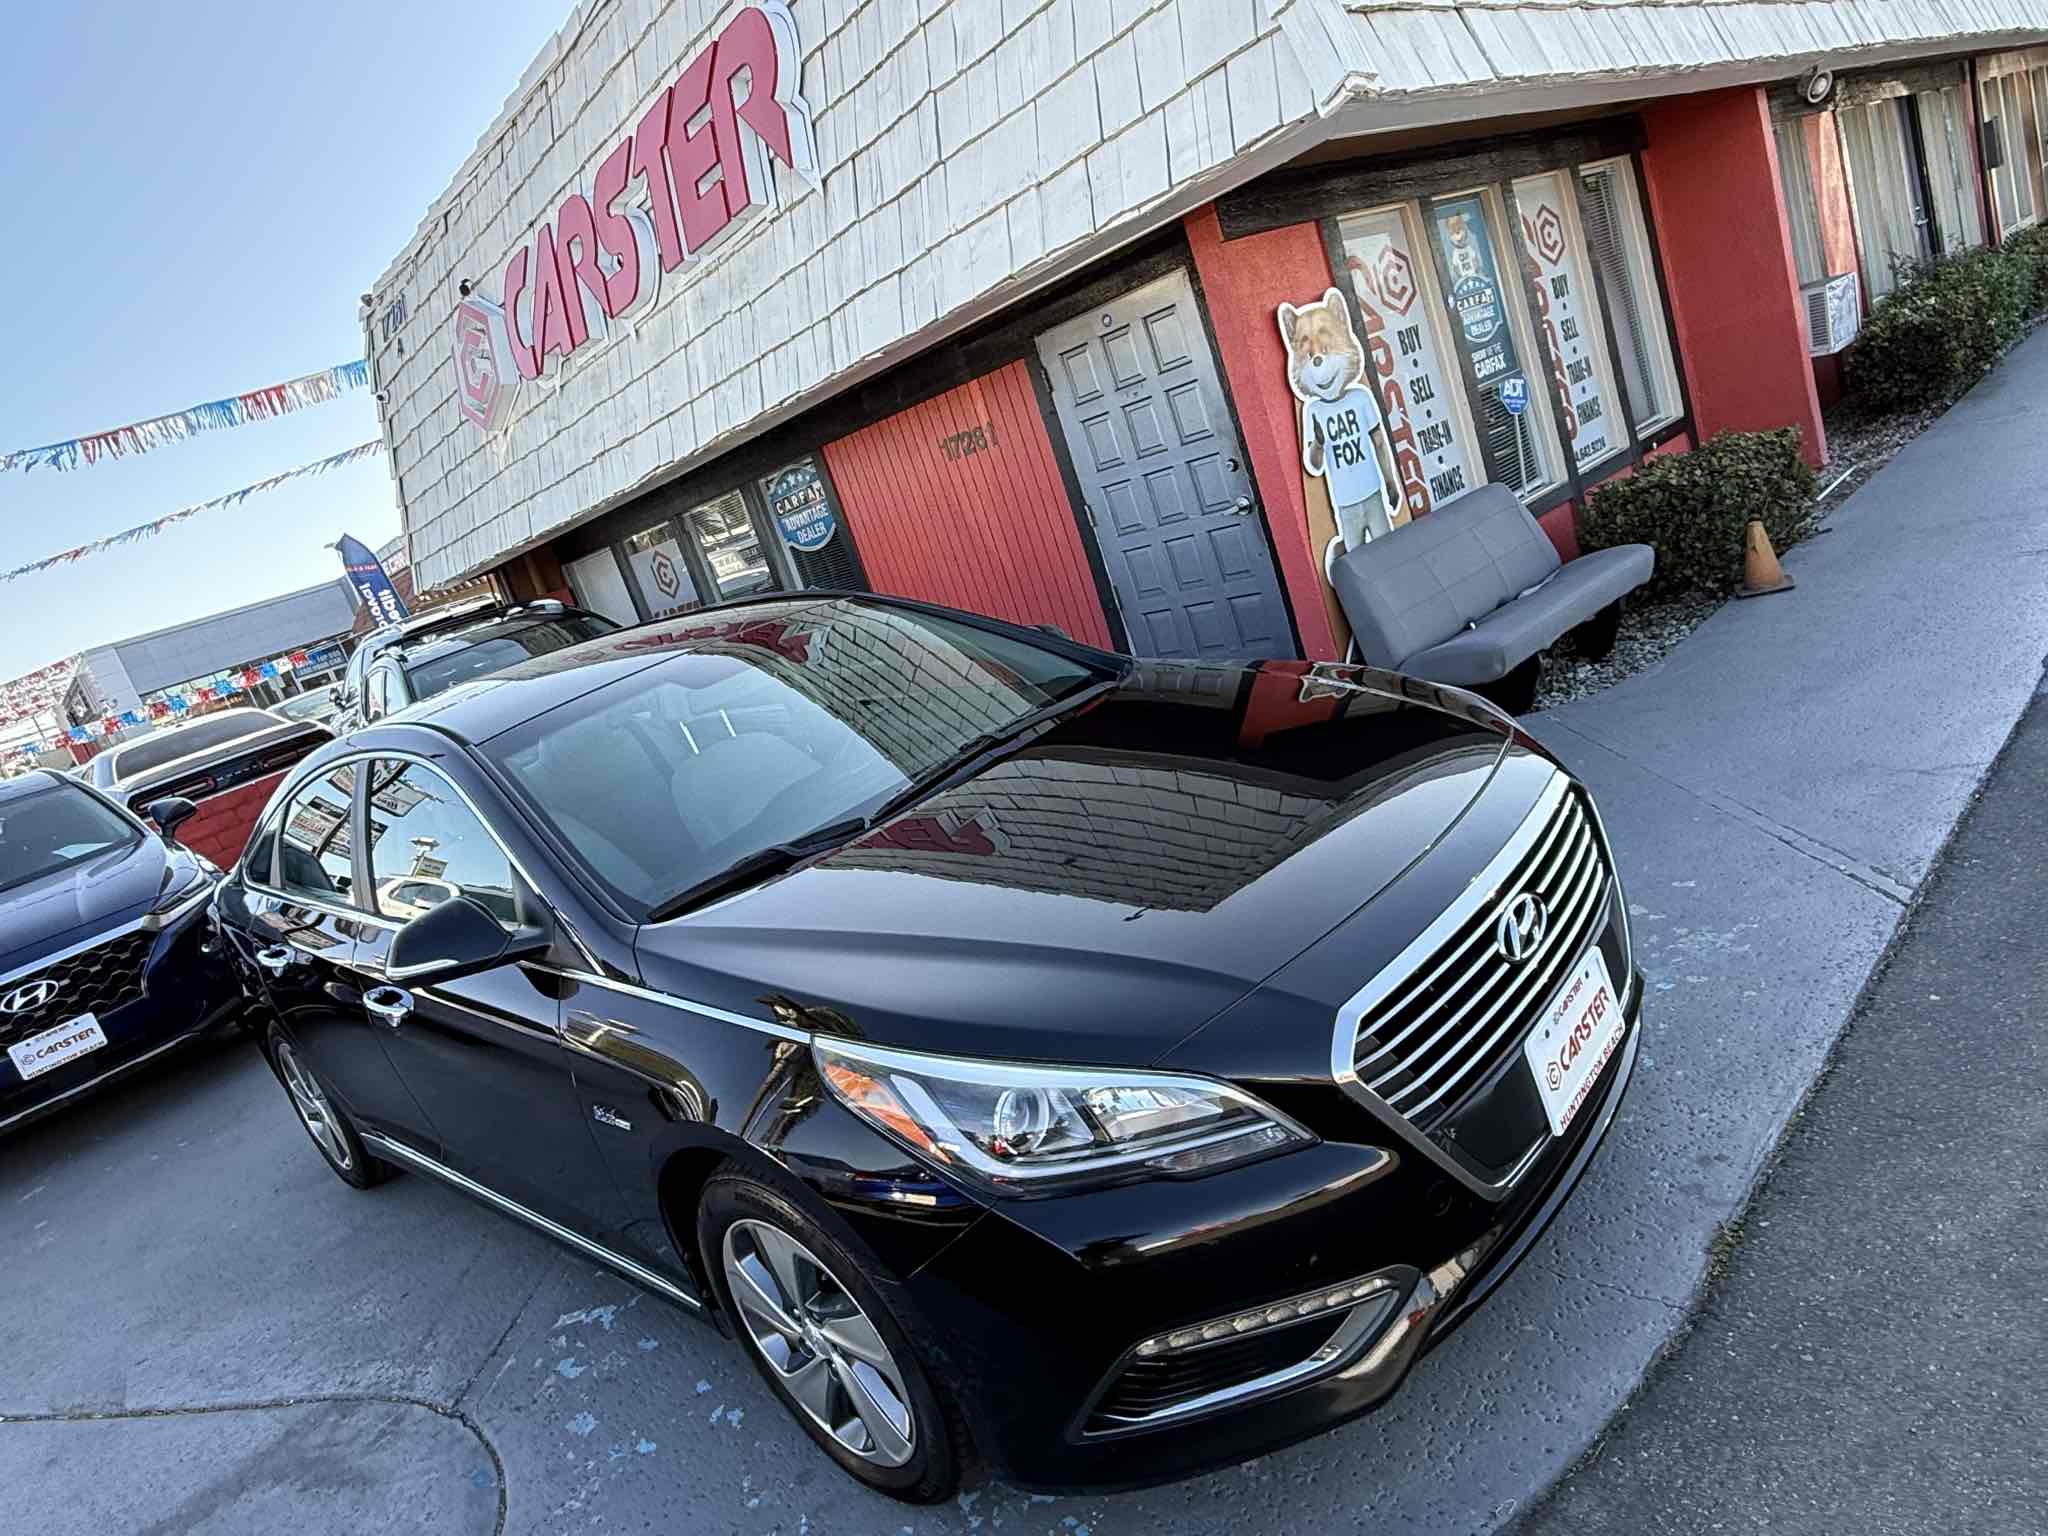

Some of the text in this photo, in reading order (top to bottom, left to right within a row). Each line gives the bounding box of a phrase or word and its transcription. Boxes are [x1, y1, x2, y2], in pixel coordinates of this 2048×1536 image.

[503, 7, 794, 381] CARSTER
[1397, 324, 1422, 356] BUY
[1560, 316, 1580, 343] SELL
[1474, 353, 1506, 379] CARFAX
[1409, 374, 1435, 405] SELL
[1503, 378, 1524, 397] ADT
[1326, 408, 1361, 441] CAR
[1417, 418, 1454, 457] TRADE-IN
[941, 421, 999, 462] 17281
[1332, 437, 1366, 469] FOX
[776, 480, 826, 515] CARFAX
[1429, 465, 1466, 503] FINANCE
[783, 503, 829, 533] ADVANTAGE
[796, 520, 828, 544] DEALER
[36, 1026, 97, 1059] CARSTER
[1560, 985, 1610, 1071] CARSTER
[1559, 1022, 1626, 1130] HUNTINGTON BEACH
